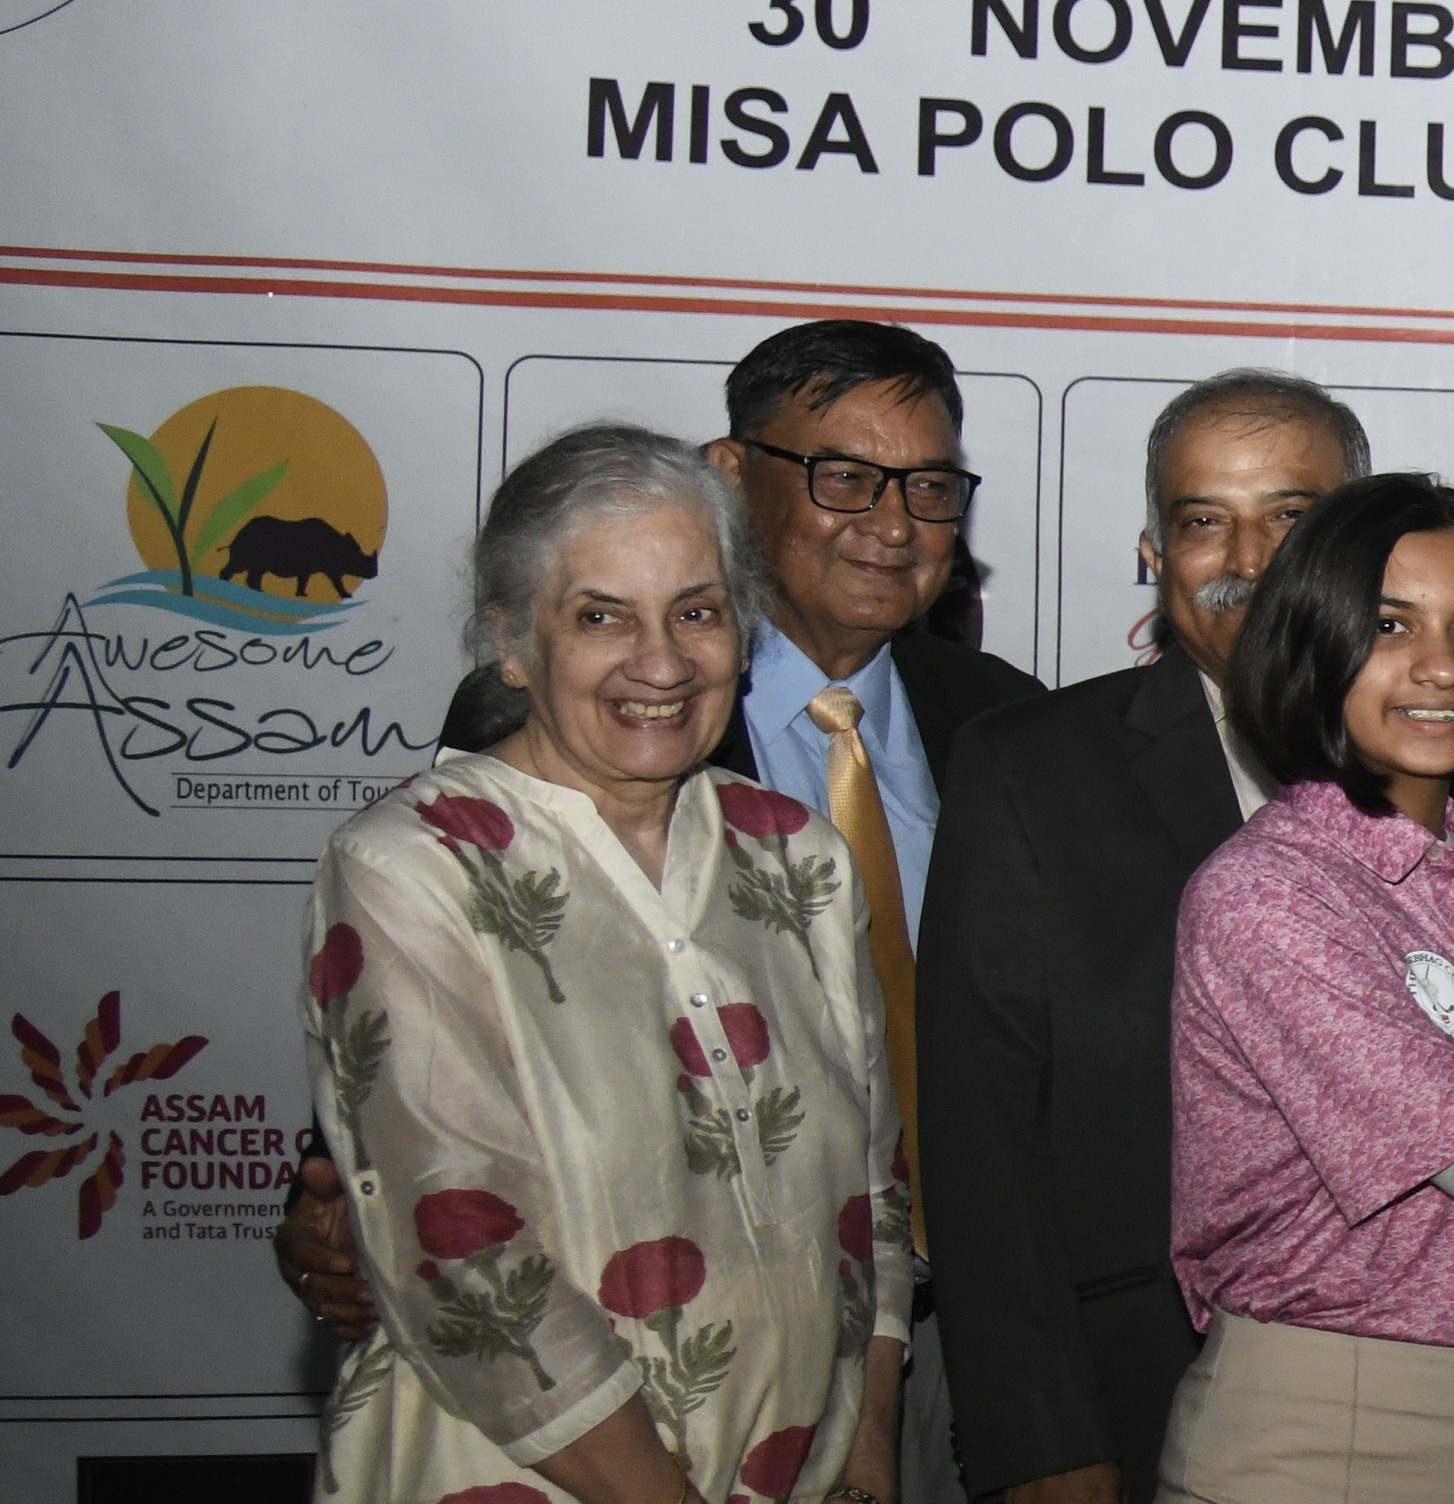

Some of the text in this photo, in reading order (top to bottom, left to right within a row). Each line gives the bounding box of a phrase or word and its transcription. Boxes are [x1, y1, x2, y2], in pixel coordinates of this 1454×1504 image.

[749, 0, 870, 49] 30
[586, 76, 880, 174] MISA
[916, 96, 1234, 190] POLO
[0, 591, 395, 695] Awesome
[0, 641, 440, 817] Assam
[176, 777, 311, 805] Department
[317, 778, 342, 802] of
[140, 1093, 266, 1123] ASSAM
[140, 1128, 286, 1157] CANCER
[141, 1160, 295, 1190] FOUNDA
[142, 1200, 157, 1217] A
[142, 1222, 279, 1240] and Tata Trus
